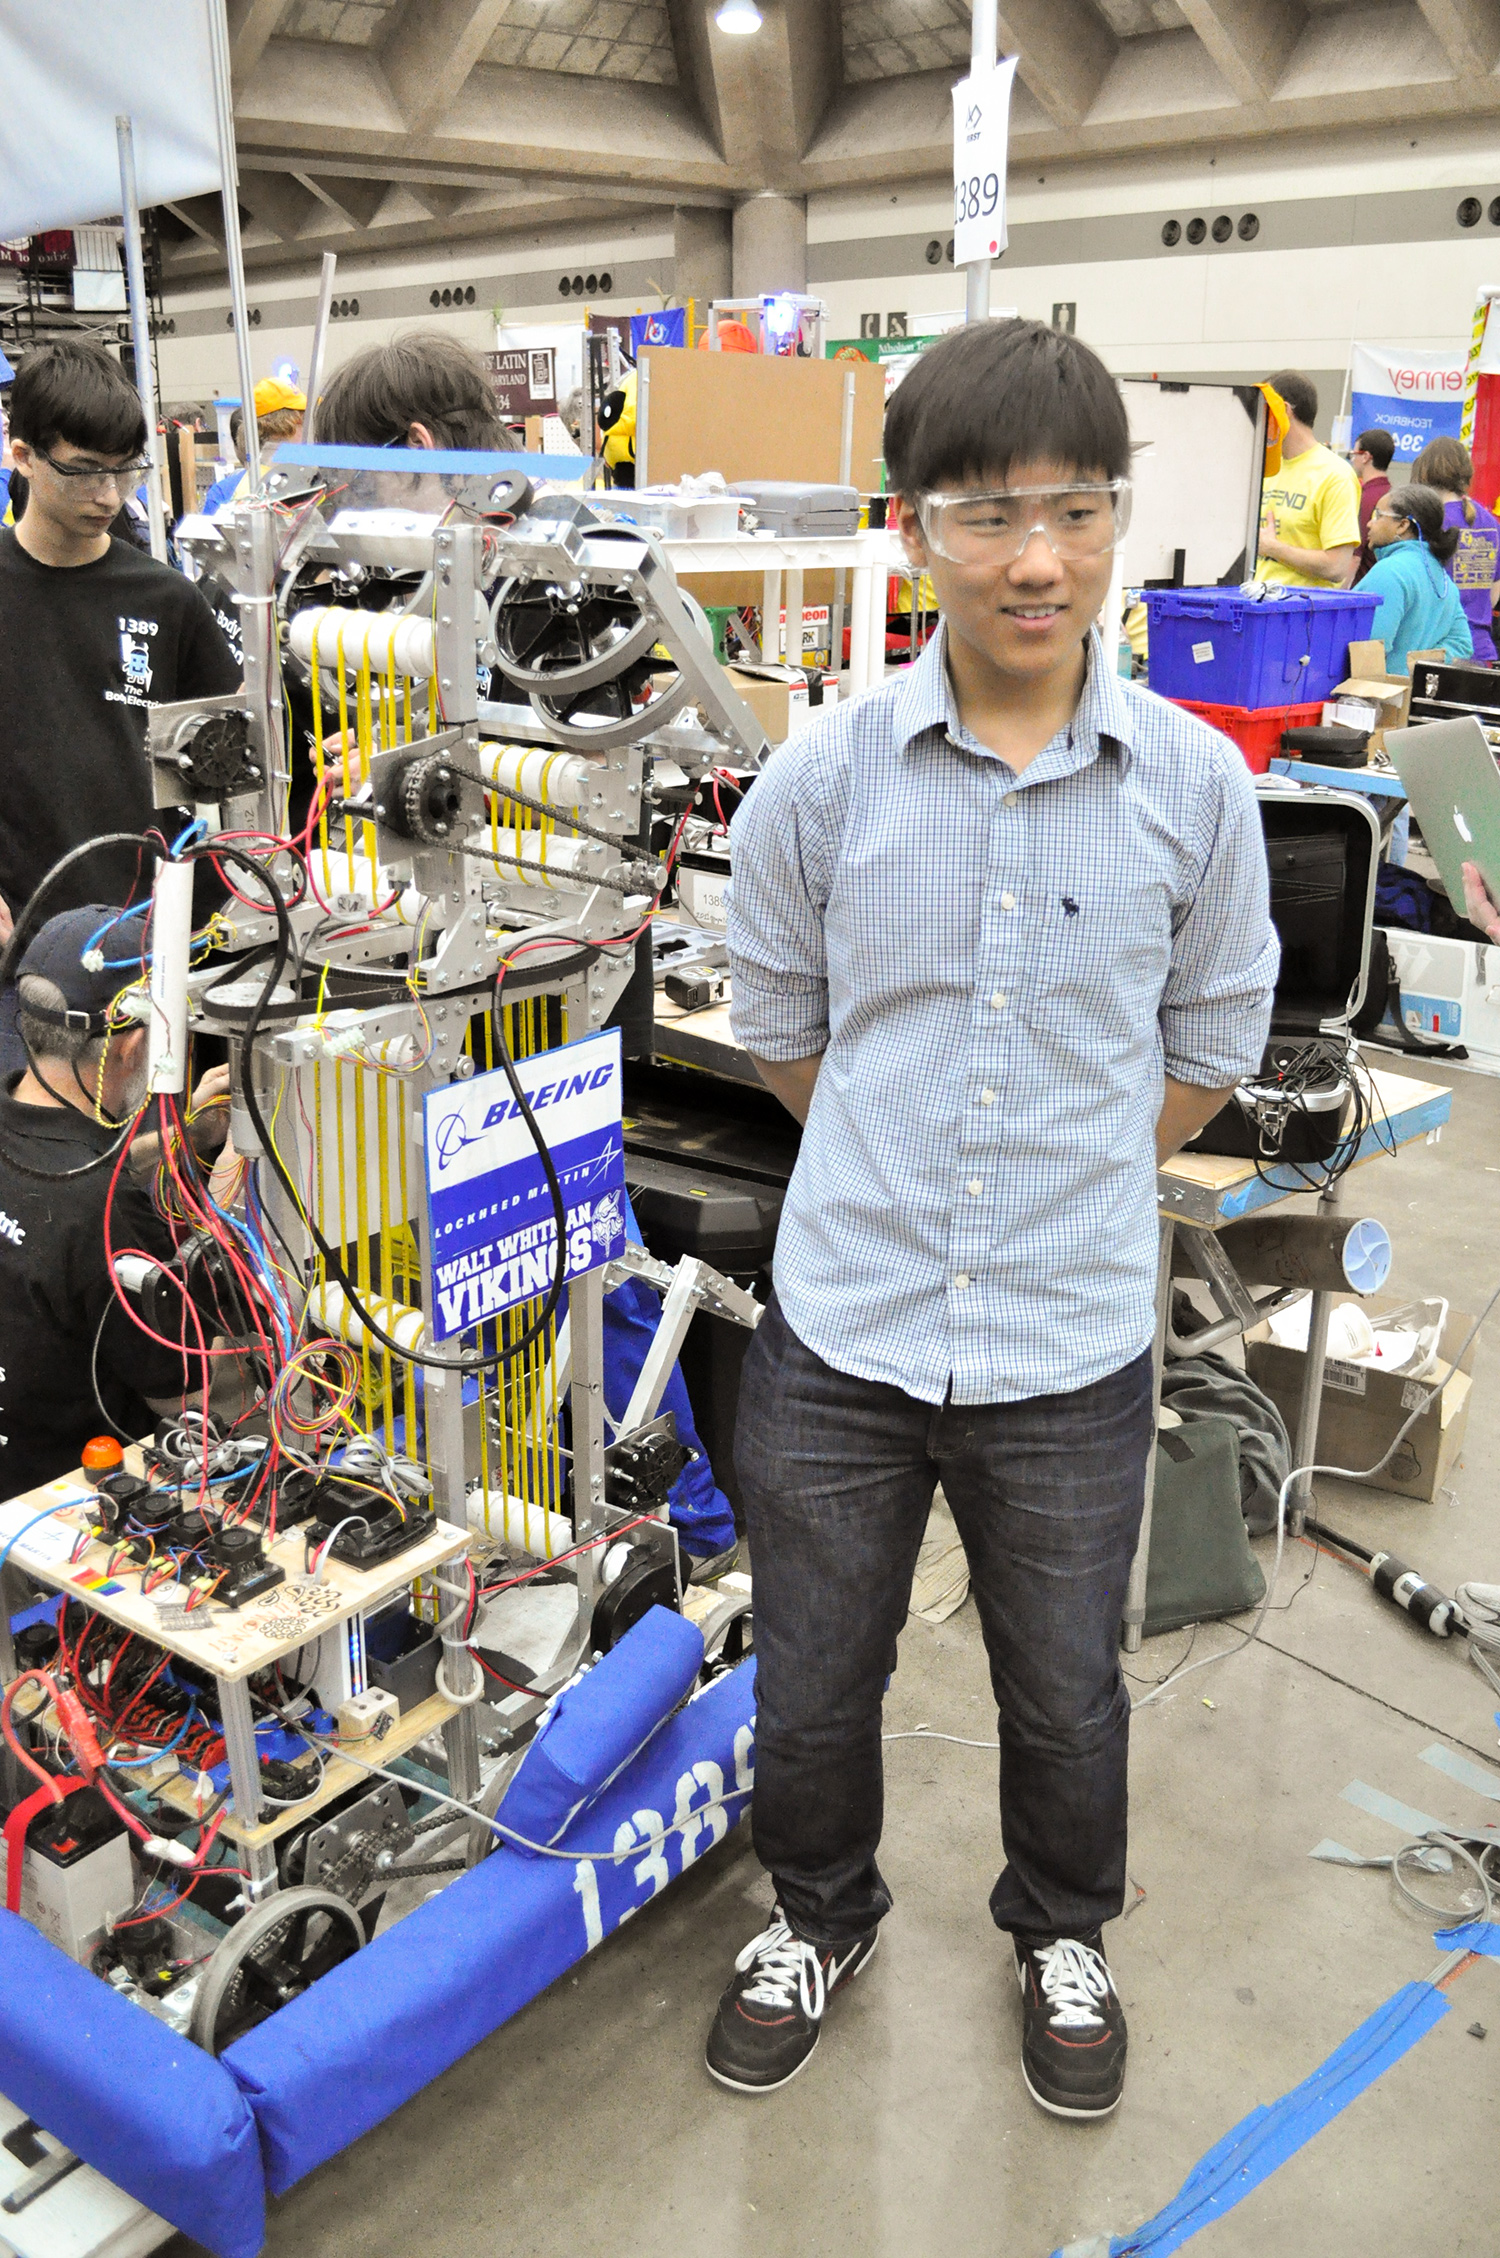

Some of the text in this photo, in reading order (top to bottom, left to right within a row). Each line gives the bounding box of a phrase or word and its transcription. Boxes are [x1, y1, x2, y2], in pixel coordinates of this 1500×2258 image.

[496, 353, 527, 370] LATIN
[495, 394, 511, 410] 34
[119, 617, 159, 636] 1389
[124, 683, 144, 696] The
[481, 1062, 614, 1130] BOEING
[434, 1166, 590, 1239] LOCKHEED MATIN
[436, 1244, 493, 1290] WALT
[437, 1226, 592, 1334] VIKINGS
